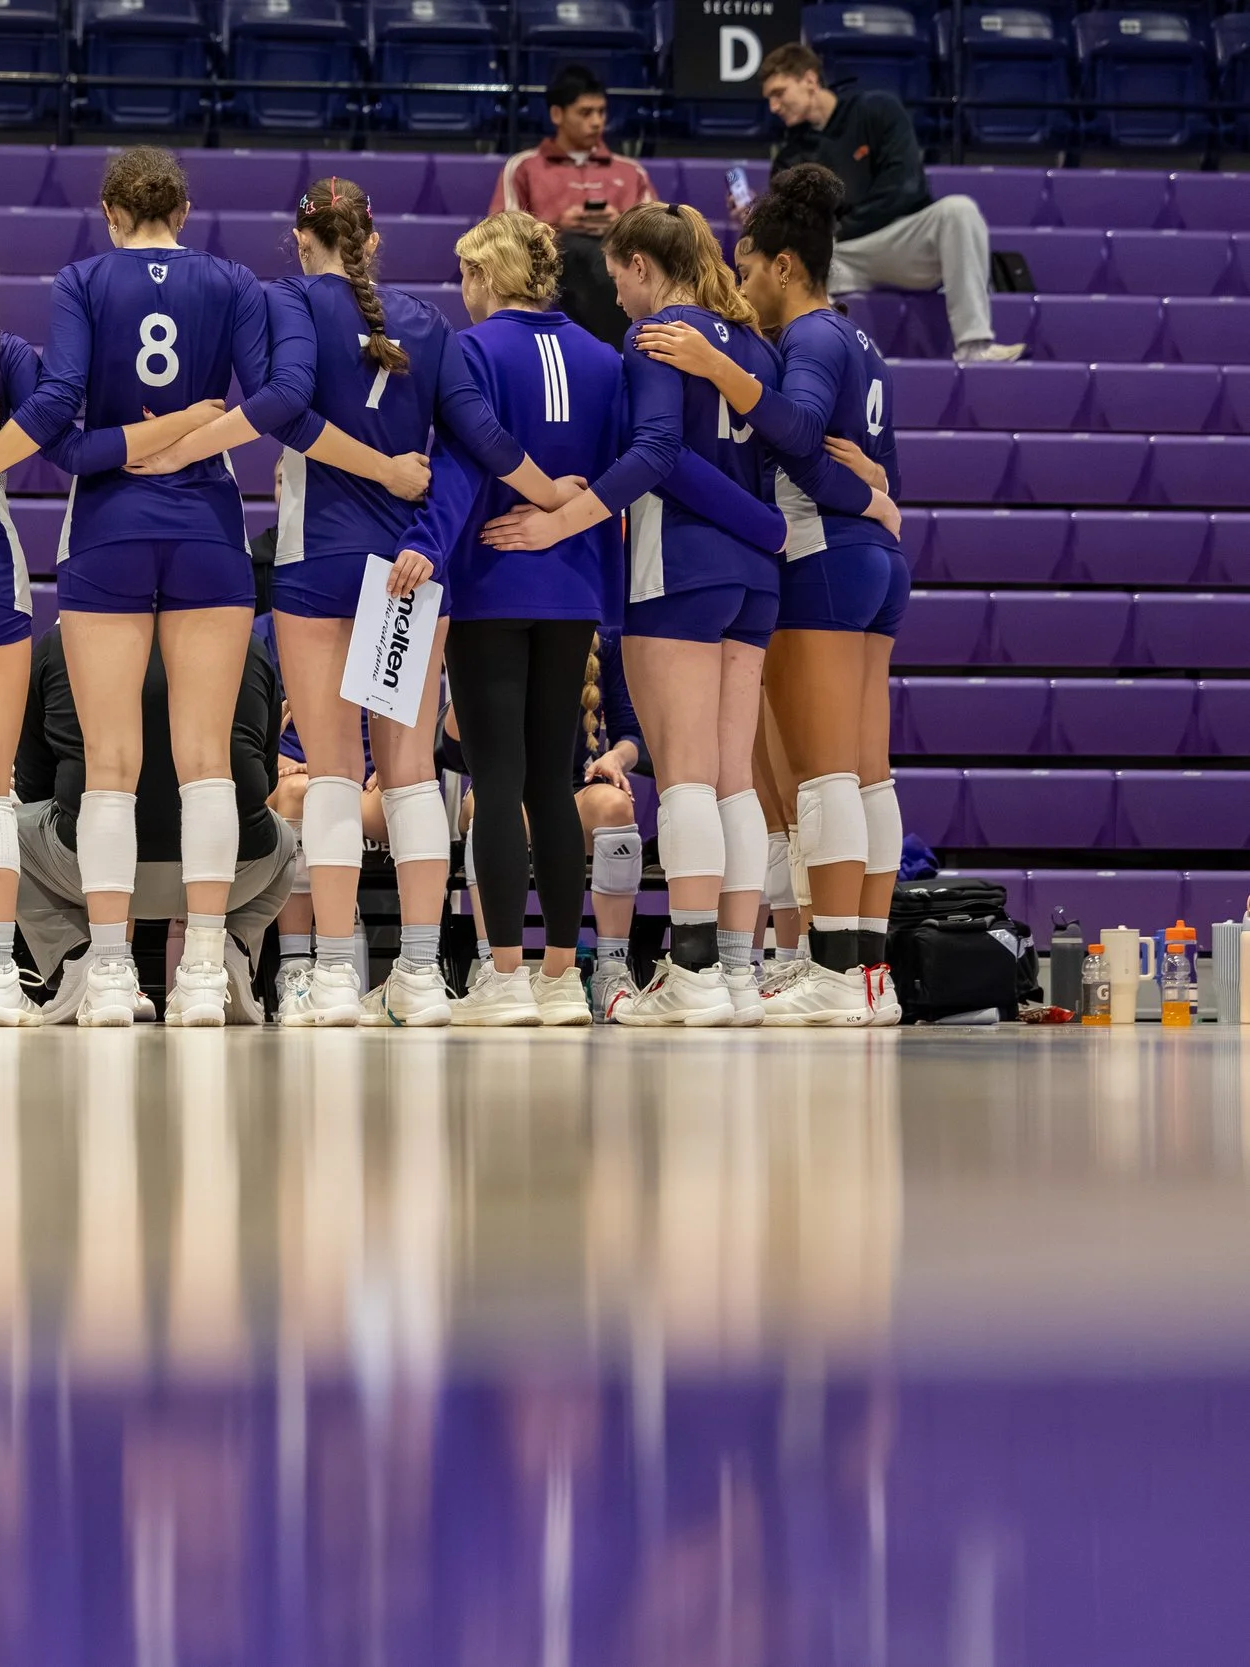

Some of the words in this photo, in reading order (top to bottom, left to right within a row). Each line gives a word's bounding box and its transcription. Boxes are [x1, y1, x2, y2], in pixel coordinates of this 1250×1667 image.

[703, 1, 774, 15] SECTION
[719, 25, 762, 82] D
[136, 312, 179, 387] 8
[358, 333, 400, 409] 7
[385, 598, 394, 619] the
[380, 619, 388, 650] real
[382, 588, 415, 688] molten
[373, 645, 383, 681] game
[1096, 984, 1110, 1001] G
